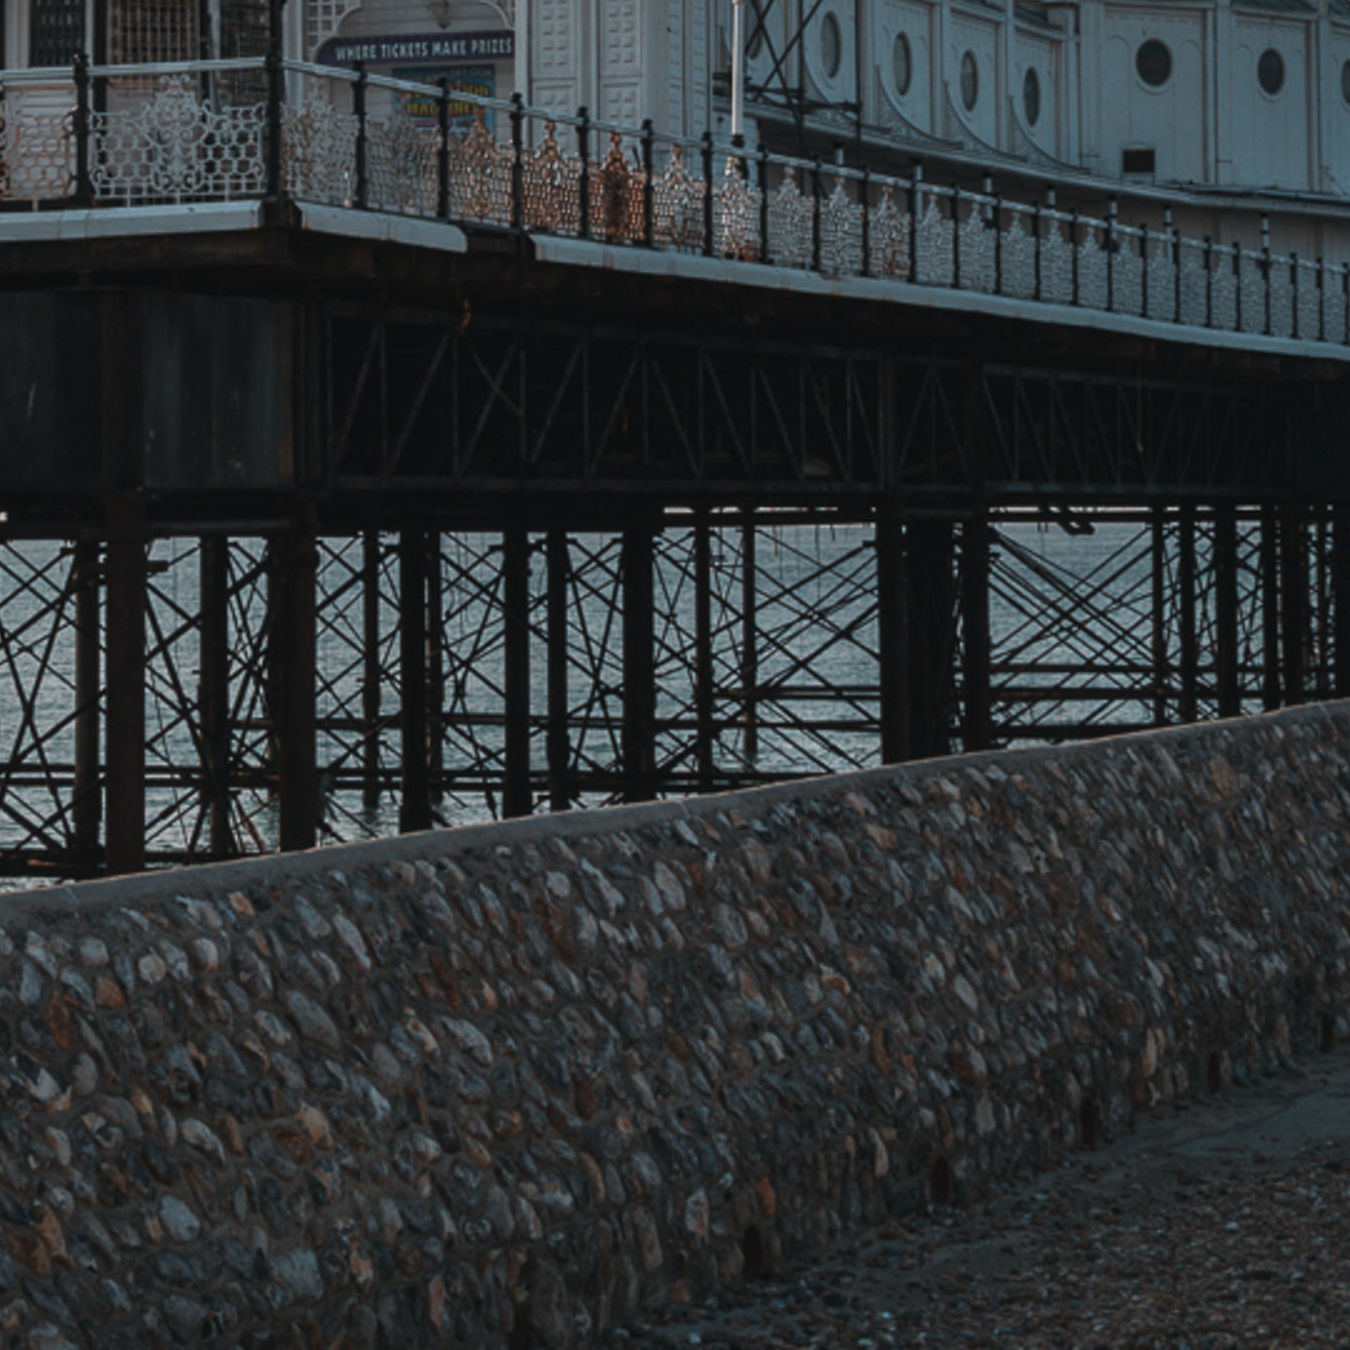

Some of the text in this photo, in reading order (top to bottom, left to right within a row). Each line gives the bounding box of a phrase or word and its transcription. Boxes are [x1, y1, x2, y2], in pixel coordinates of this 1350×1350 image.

[335, 37, 512, 61] WHERE TICKETS MAKE PRIZES
